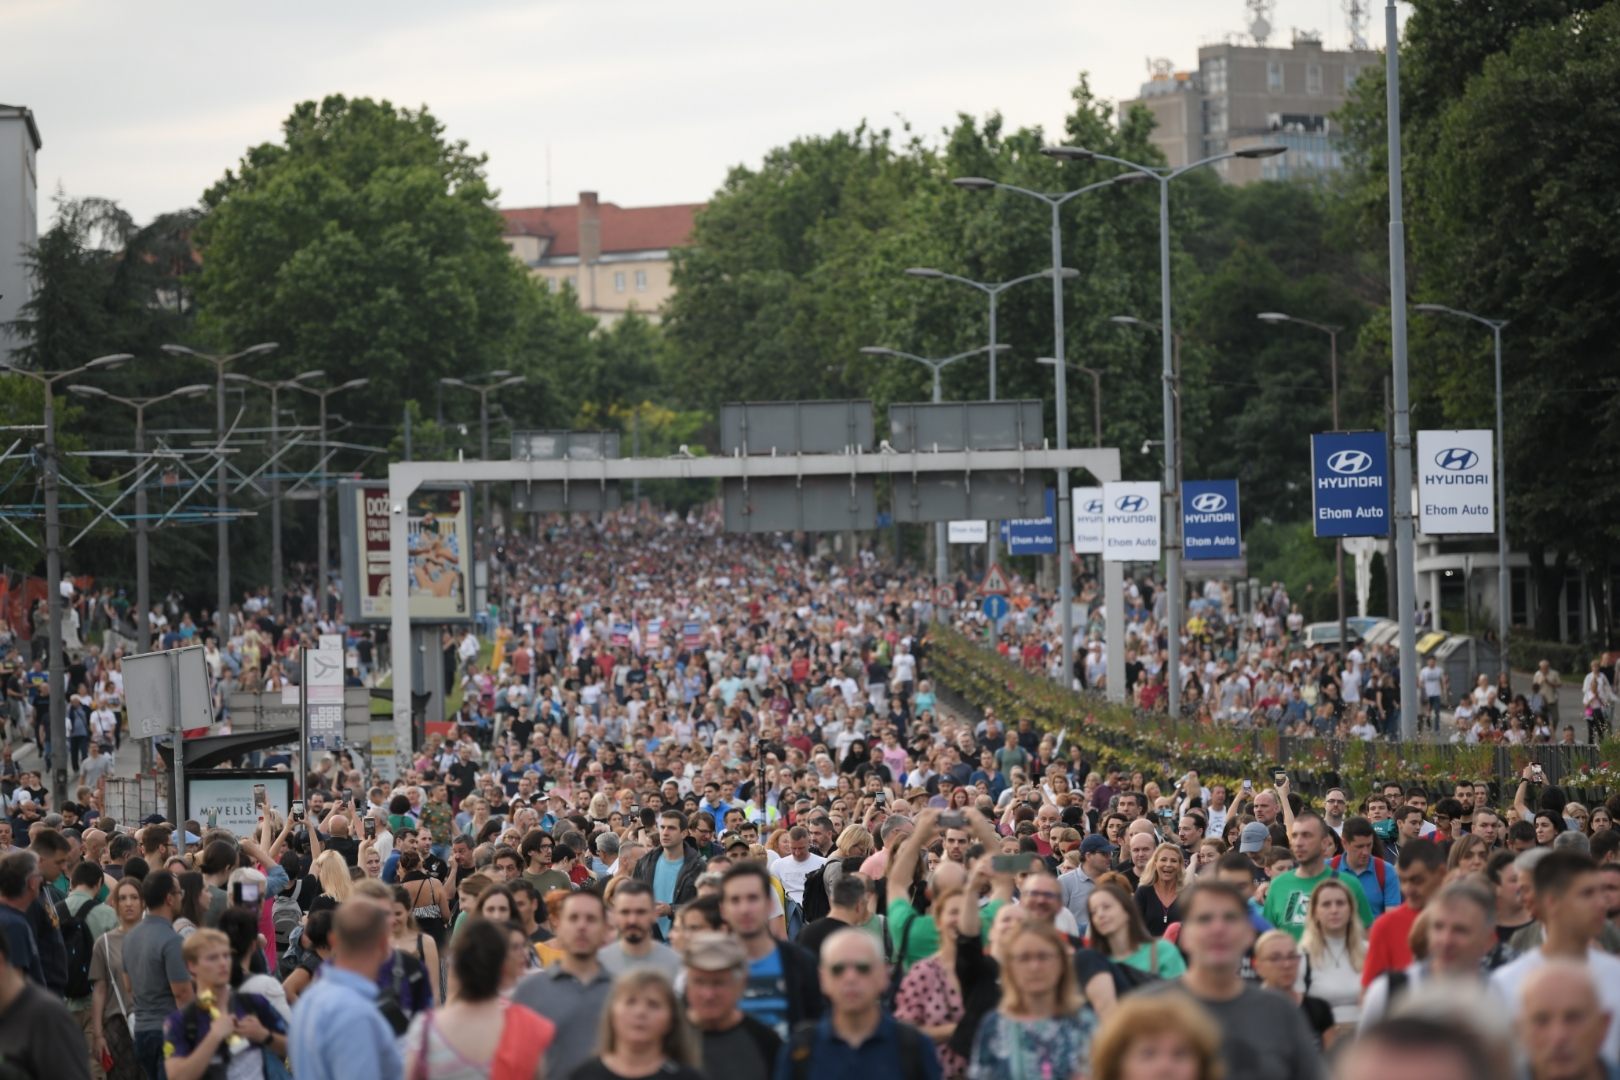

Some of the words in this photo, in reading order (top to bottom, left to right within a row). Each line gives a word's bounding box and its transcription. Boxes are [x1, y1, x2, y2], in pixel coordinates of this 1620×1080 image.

[1318, 476, 1382, 489] HYUNDAI
[1426, 475, 1488, 485] HYUNDAI
[1319, 507, 1352, 519] Ehom
[1355, 506, 1384, 518] Auto
[1425, 504, 1457, 515] Ehom
[1462, 504, 1489, 515] Auto
[1108, 515, 1157, 523] HYUNDAI
[1185, 513, 1235, 523] HYUNDAI
[1011, 536, 1033, 544] Ehom
[1035, 535, 1053, 544] Auto
[1108, 539, 1133, 547] Ehom
[1136, 538, 1157, 546] Auto
[1186, 537, 1212, 547] Ehom
[1213, 535, 1236, 546] Auto
